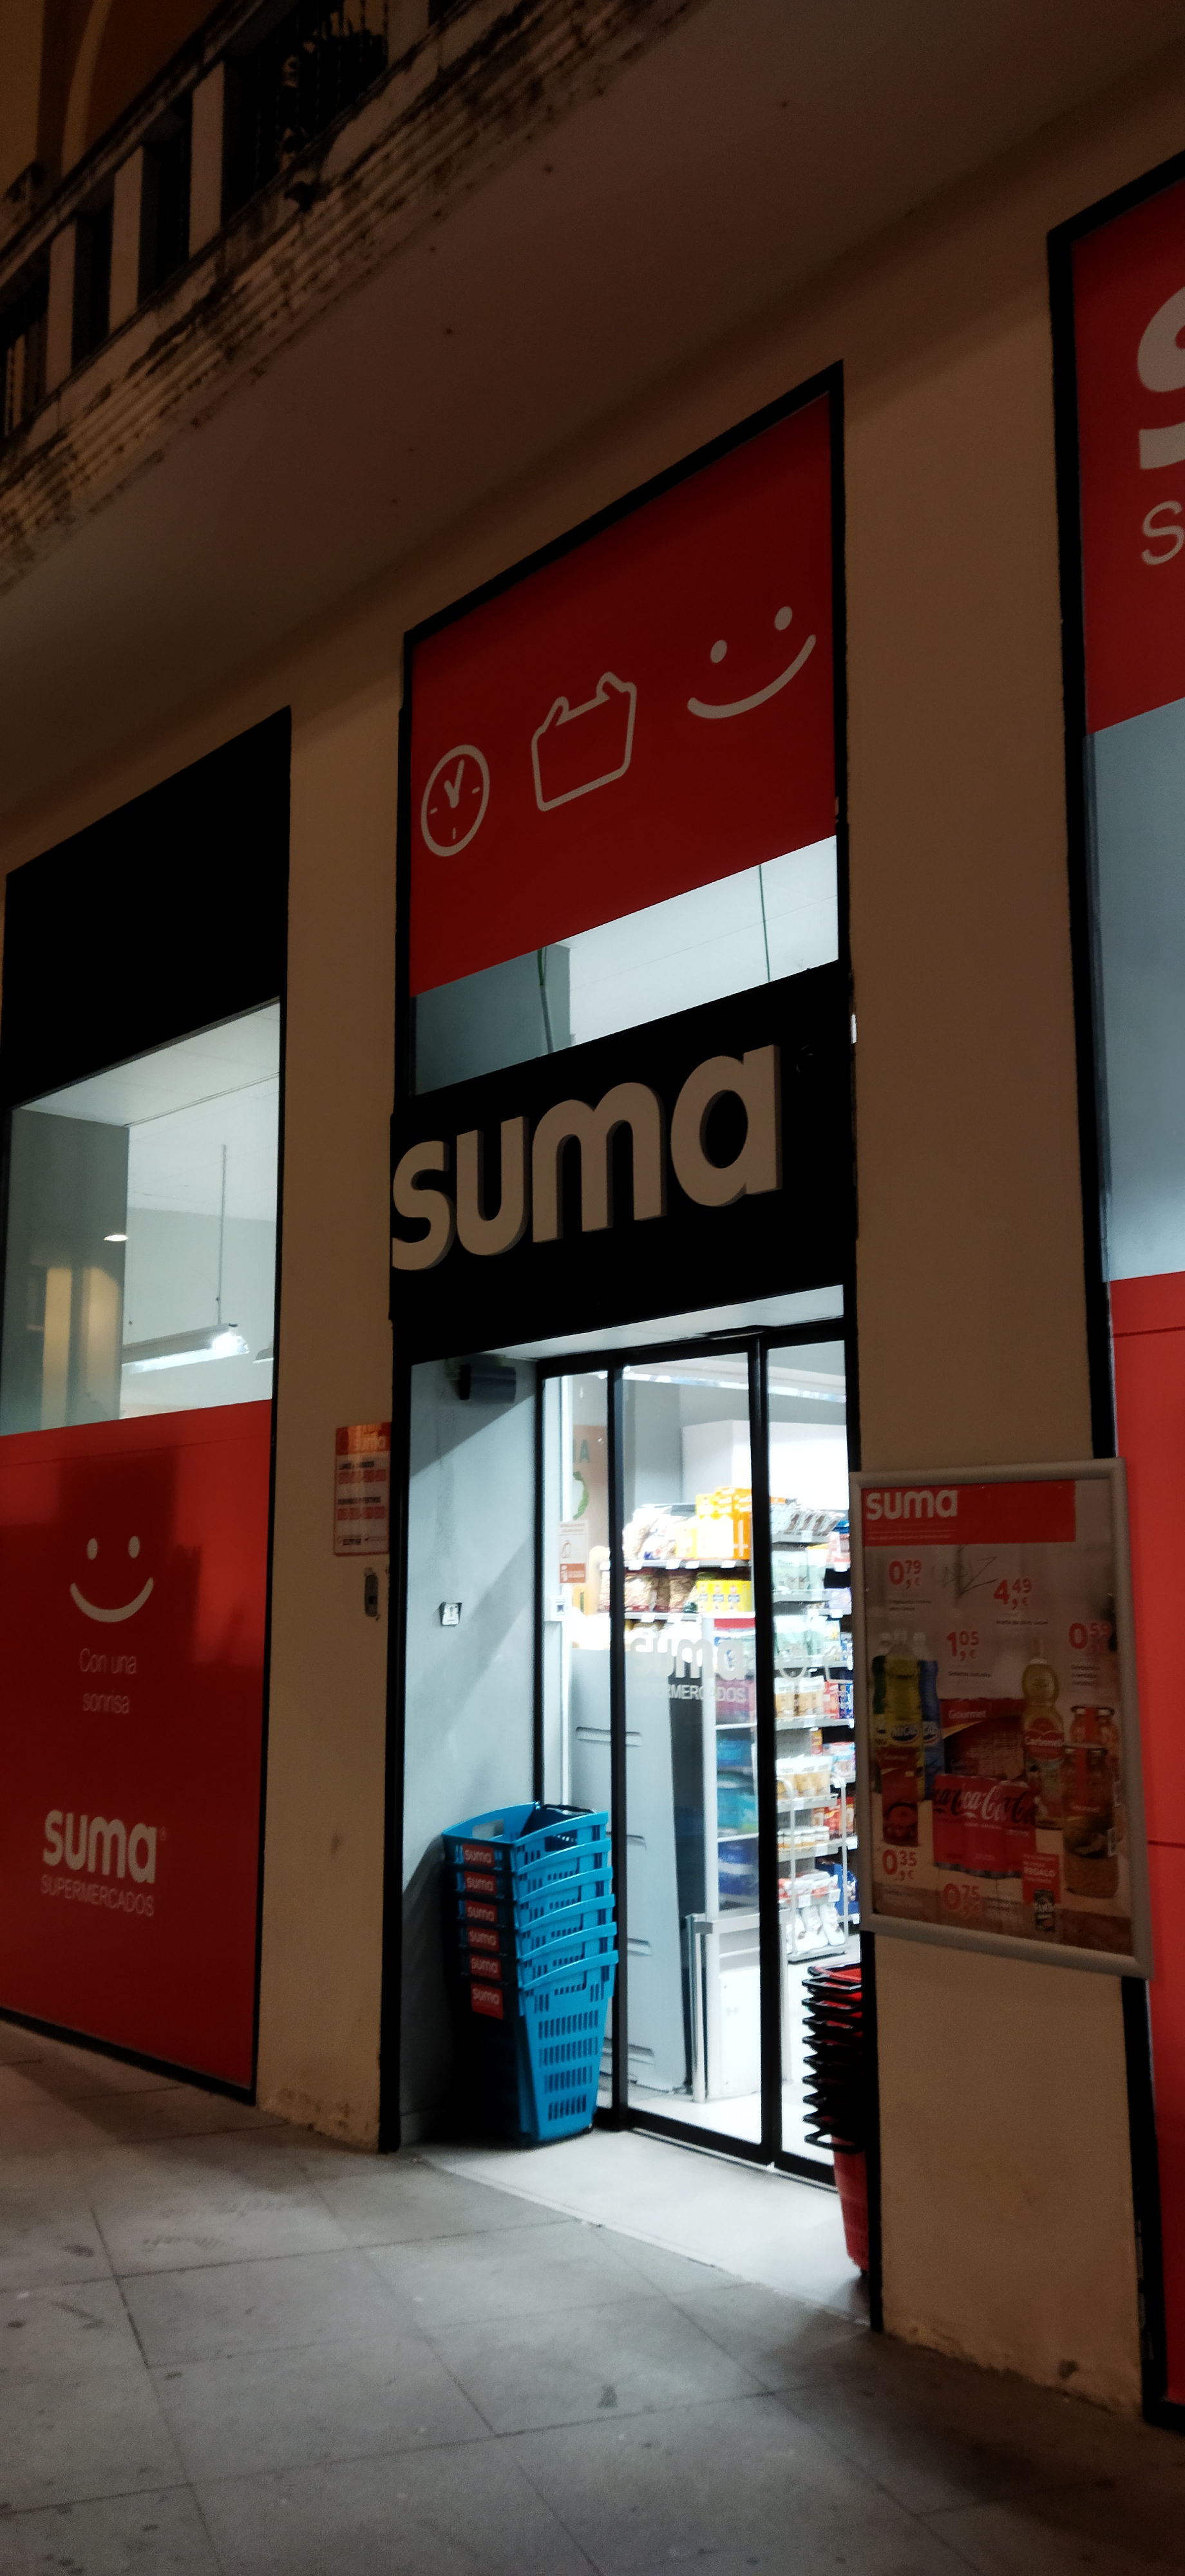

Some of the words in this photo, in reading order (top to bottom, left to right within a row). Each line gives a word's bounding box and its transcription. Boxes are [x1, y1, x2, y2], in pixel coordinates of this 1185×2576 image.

[392, 1044, 783, 1271] suma
[866, 1489, 958, 1520] suma
[79, 1647, 107, 1674] Con
[110, 1651, 137, 1675] una
[82, 1691, 131, 1715] sonrisa
[42, 1809, 157, 1884] suma
[41, 1873, 155, 1918] SUPERMERCADOS
